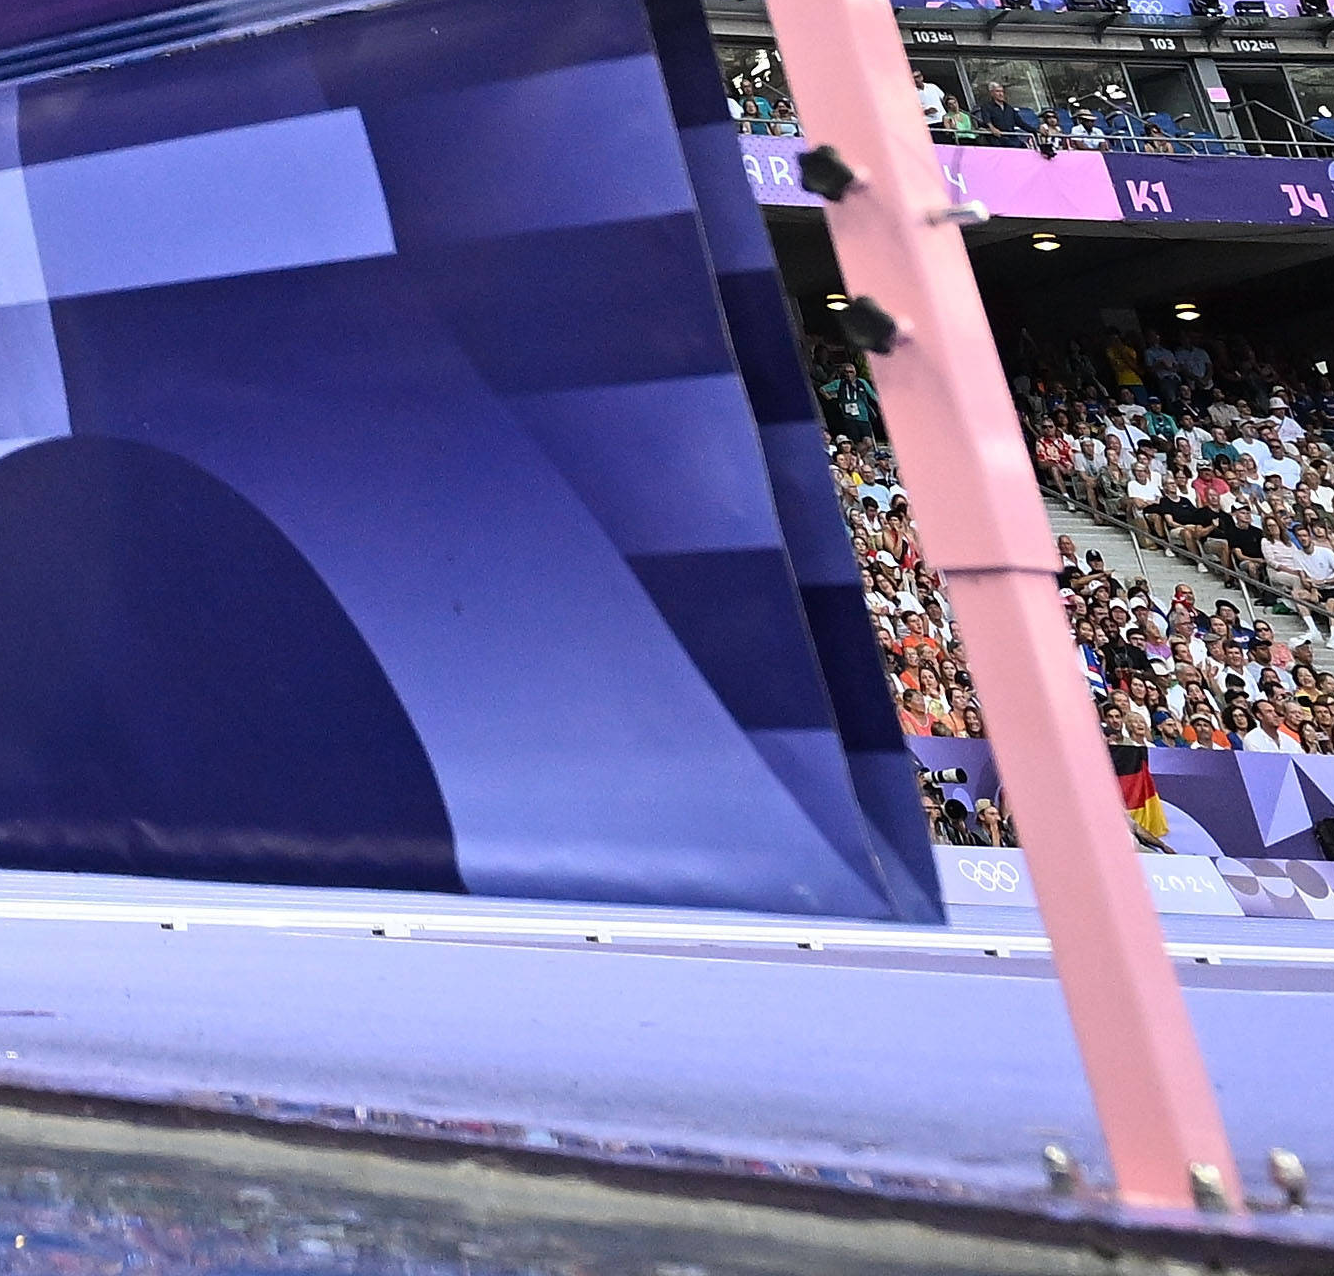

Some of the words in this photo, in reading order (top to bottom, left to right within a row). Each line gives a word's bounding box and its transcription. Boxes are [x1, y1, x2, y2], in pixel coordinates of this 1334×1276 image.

[1149, 37, 1176, 51] 103
[1125, 180, 1173, 213] K1
[1280, 183, 1329, 218] J4
